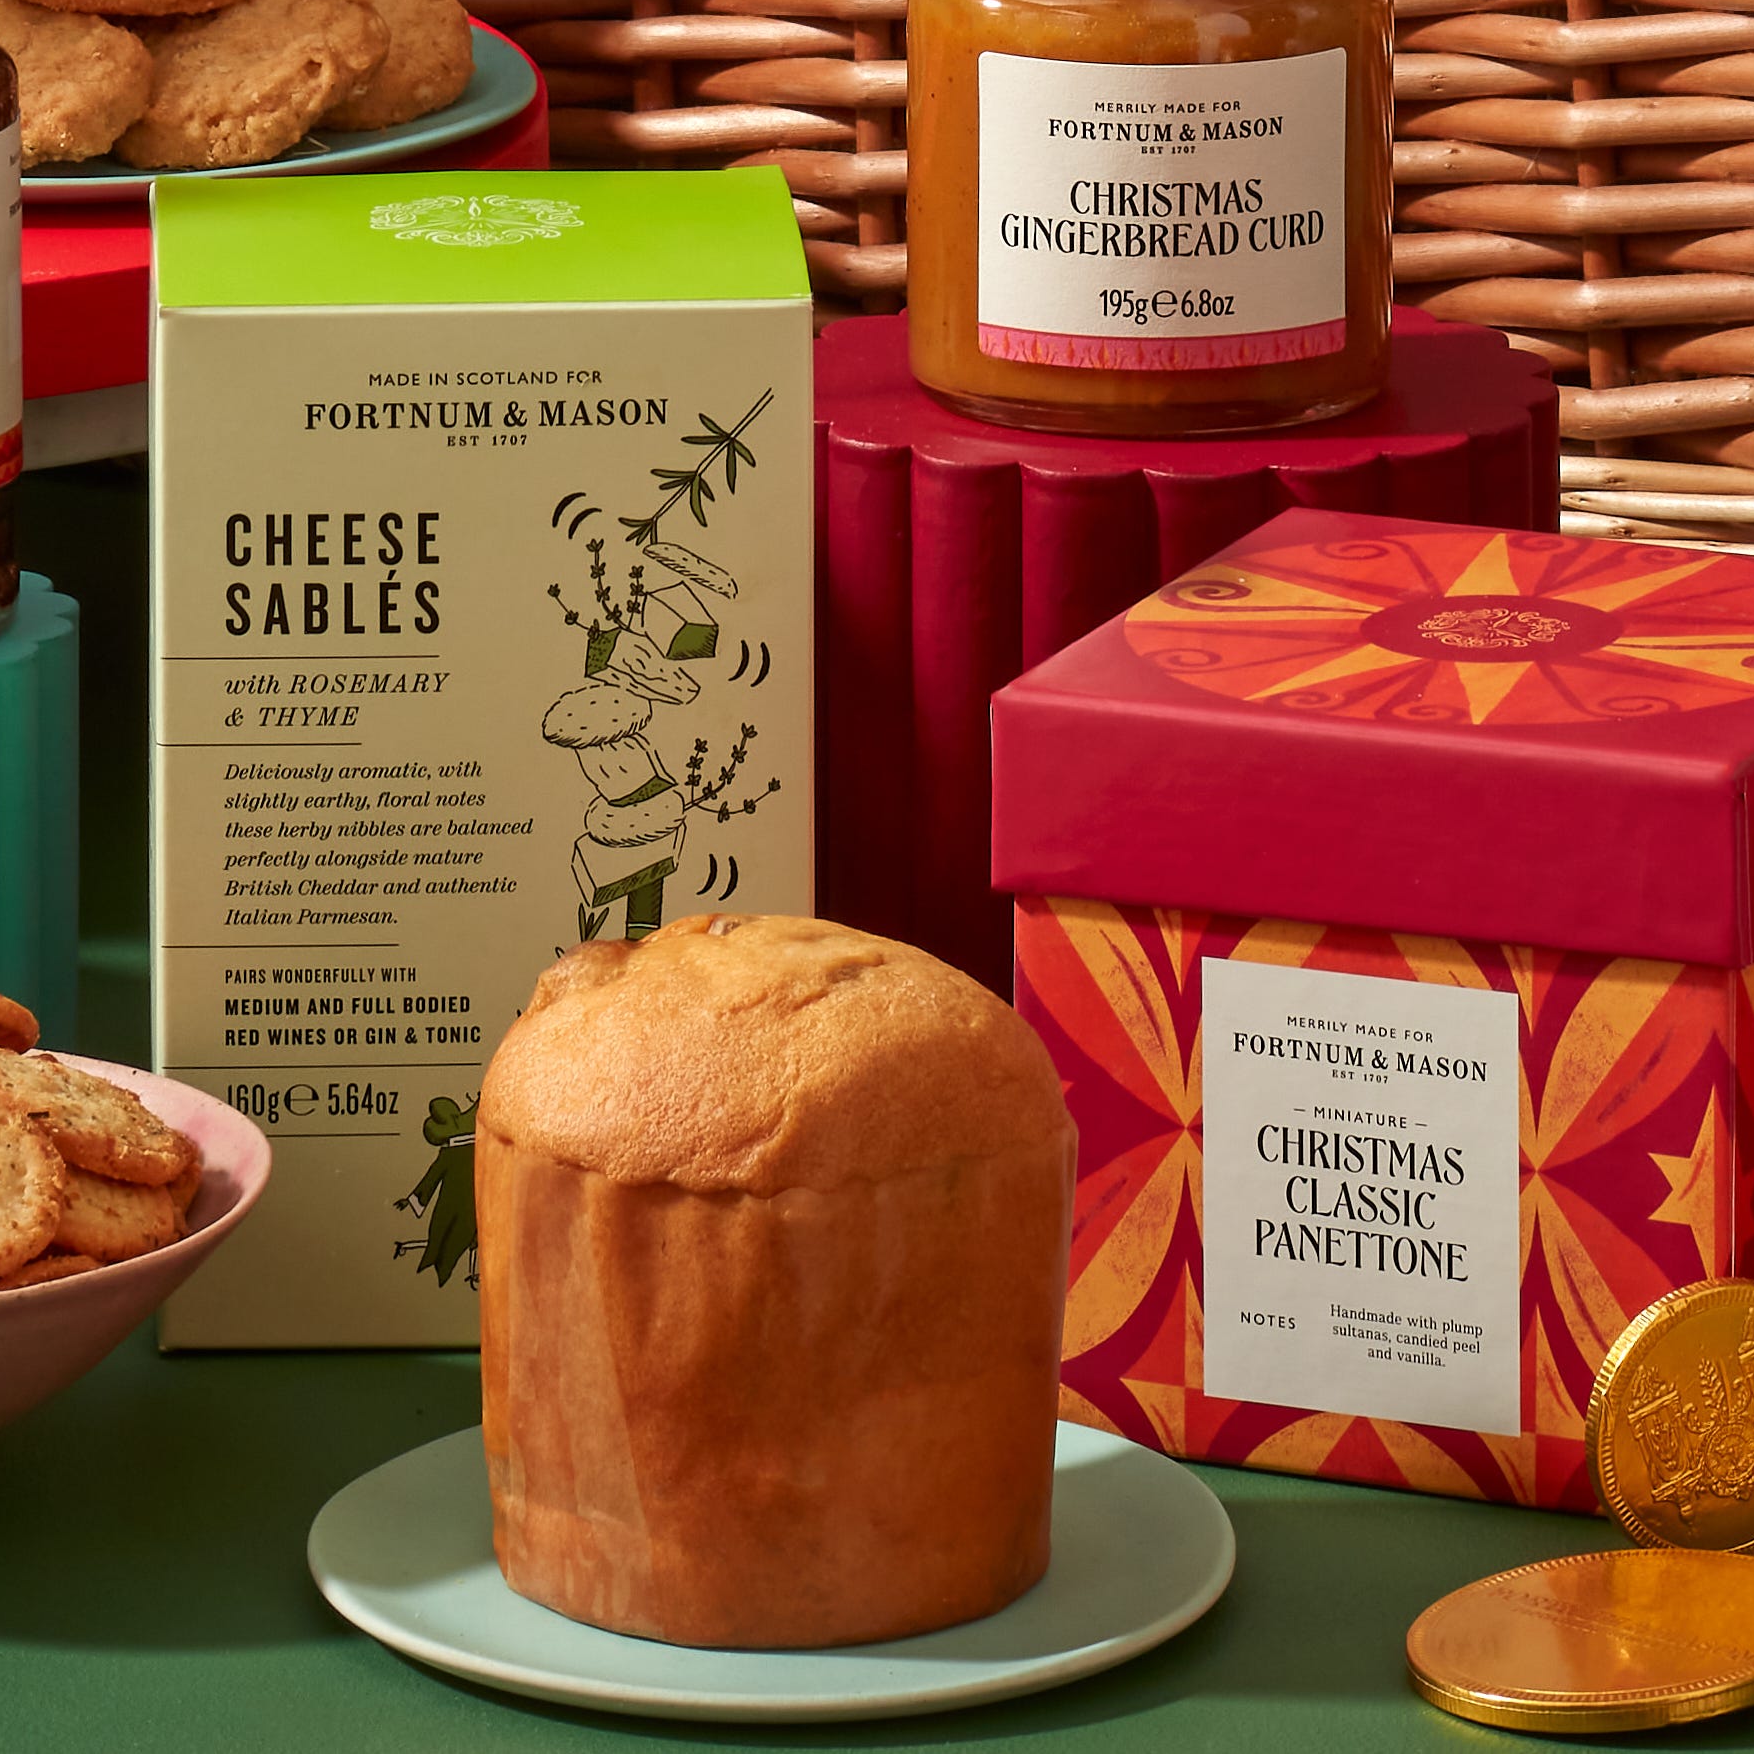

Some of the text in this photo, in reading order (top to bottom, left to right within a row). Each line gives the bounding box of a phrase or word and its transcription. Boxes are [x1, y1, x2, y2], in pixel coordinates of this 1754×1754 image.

[1048, 115, 1284, 143] FORTNUM & MASON
[1070, 178, 1263, 218] CHRISTMAS
[1000, 209, 1324, 258] GINGERBREAD CURD
[368, 370, 603, 387] MADE IN SCOTLAND FOR
[304, 398, 669, 431] FORTNUM & MASON
[225, 511, 440, 568] CHEESE
[225, 568, 440, 637] SABLÉS
[224, 672, 451, 695] with ROSEMARY
[224, 705, 360, 728] & THYME
[223, 760, 483, 783] Deliciously aromatic, with
[224, 966, 417, 985] PAIRS WONDERFULLY WITH
[1233, 1031, 1487, 1082] FORTNUM & MASON
[1313, 1105, 1407, 1129] MINIATURE
[1257, 1124, 1465, 1186] CHRISTMAS
[1285, 1175, 1437, 1231] CLASSIC
[1255, 1218, 1469, 1283] PANETTONE
[1240, 1311, 1296, 1330] NOTES
[1330, 1303, 1483, 1339] Handmade with plump
